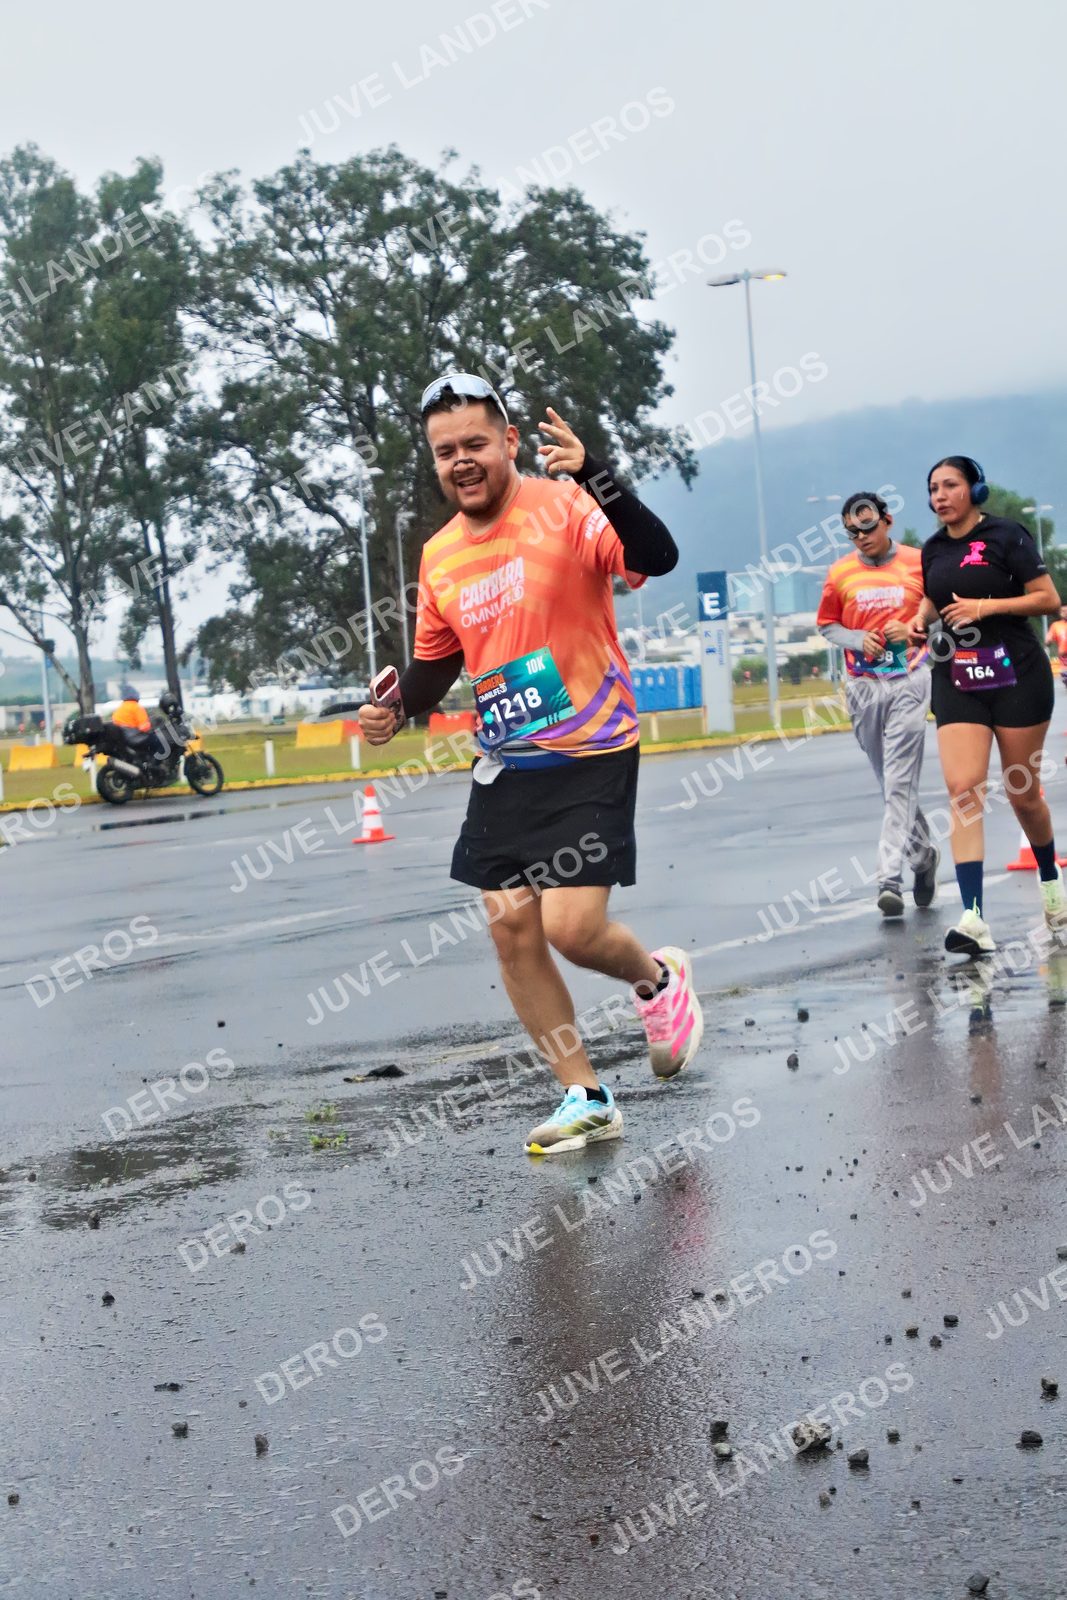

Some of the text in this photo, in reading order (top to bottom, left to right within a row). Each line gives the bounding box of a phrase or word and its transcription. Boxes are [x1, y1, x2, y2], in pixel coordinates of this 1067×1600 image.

[703, 592, 720, 616] E
[525, 655, 546, 675] 10K
[965, 666, 995, 679] 164
[489, 687, 542, 722] 1218
